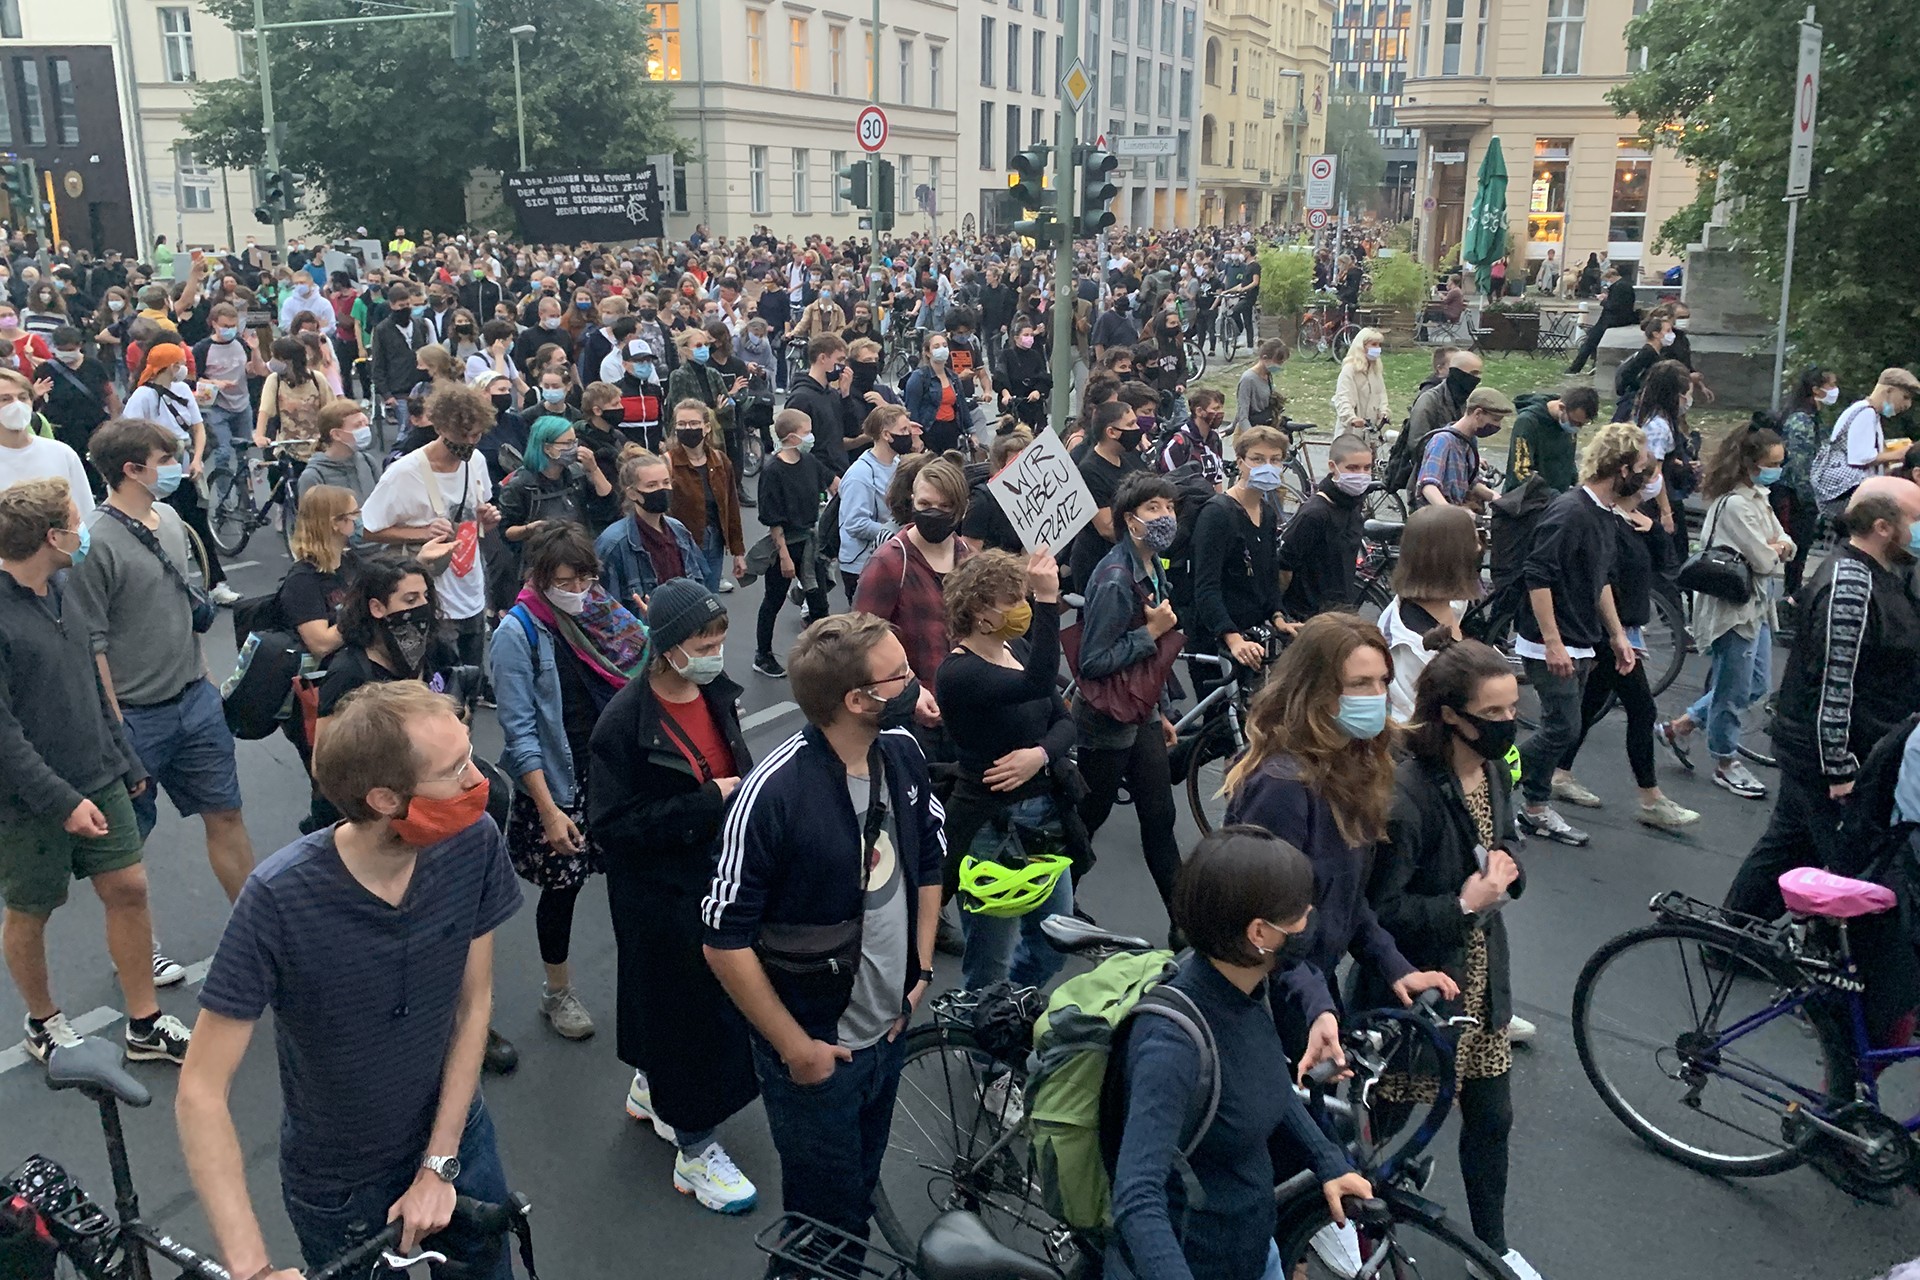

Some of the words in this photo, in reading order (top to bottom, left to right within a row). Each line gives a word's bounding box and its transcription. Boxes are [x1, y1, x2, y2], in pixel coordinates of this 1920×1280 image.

[863, 119, 881, 139] 30
[1123, 140, 1169, 151] Luisenstraße
[509, 178, 522, 186] AN
[583, 174, 600, 183] DES
[636, 170, 652, 180] AUF
[517, 188, 536, 197] DEM
[539, 185, 567, 195] GRUND
[570, 184, 587, 193] DER
[524, 198, 549, 208] SICH
[553, 196, 569, 205] DIE
[572, 195, 625, 204] SICHERHEIT
[629, 193, 647, 202] VON
[581, 204, 626, 215] EUROPÄER
[1312, 215, 1323, 224] 30
[1002, 444, 1055, 495] WIR
[1012, 459, 1070, 531] HABEN
[1034, 490, 1082, 547] PLATZ
